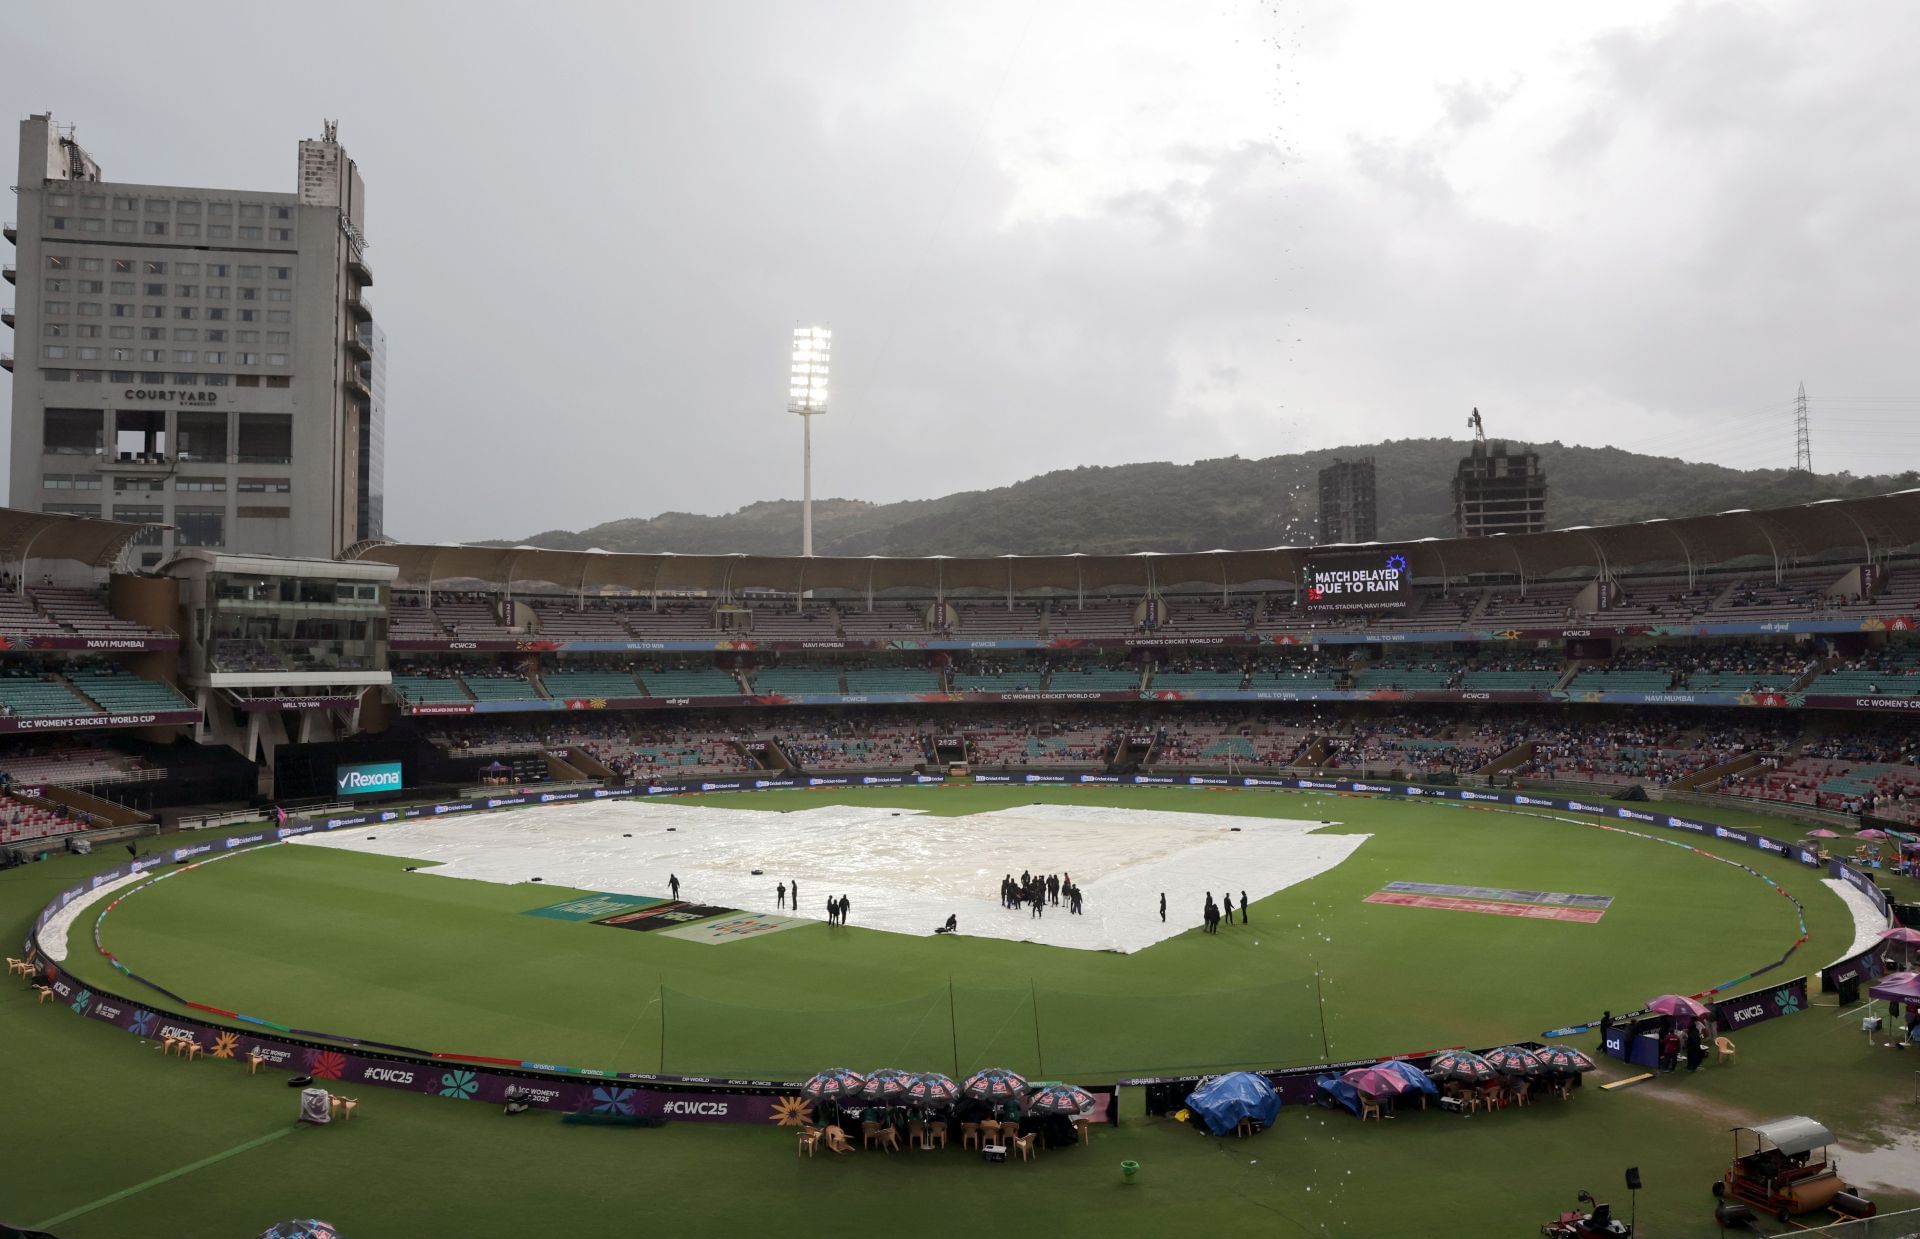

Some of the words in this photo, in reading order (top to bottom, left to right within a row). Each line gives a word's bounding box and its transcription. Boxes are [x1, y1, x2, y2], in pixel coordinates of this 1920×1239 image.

[125, 390, 217, 402] COURTYARD
[1316, 571, 1350, 583] MATCH
[1353, 569, 1399, 581] DELAYED
[1316, 583, 1342, 594] DUE
[1345, 582, 1363, 593] TO
[1367, 581, 1399, 592] RAIN
[18, 721, 32, 729] ICC
[34, 719, 73, 728] WOMEN'S
[75, 718, 108, 727] CRICKET
[110, 716, 138, 725] WORLD
[140, 715, 156, 723] CUP
[350, 772, 399, 788] Rexona
[53, 981, 71, 997] #CWC25
[1734, 1004, 1763, 1022] #CWC25
[160, 1026, 195, 1041] #CWC25
[270, 1050, 291, 1058] WOMEN'S
[364, 1067, 414, 1084] #CWC25
[530, 1089, 560, 1098] WOMEN'S
[532, 1095, 550, 1103] 2025
[663, 1101, 728, 1116] #CWC25
